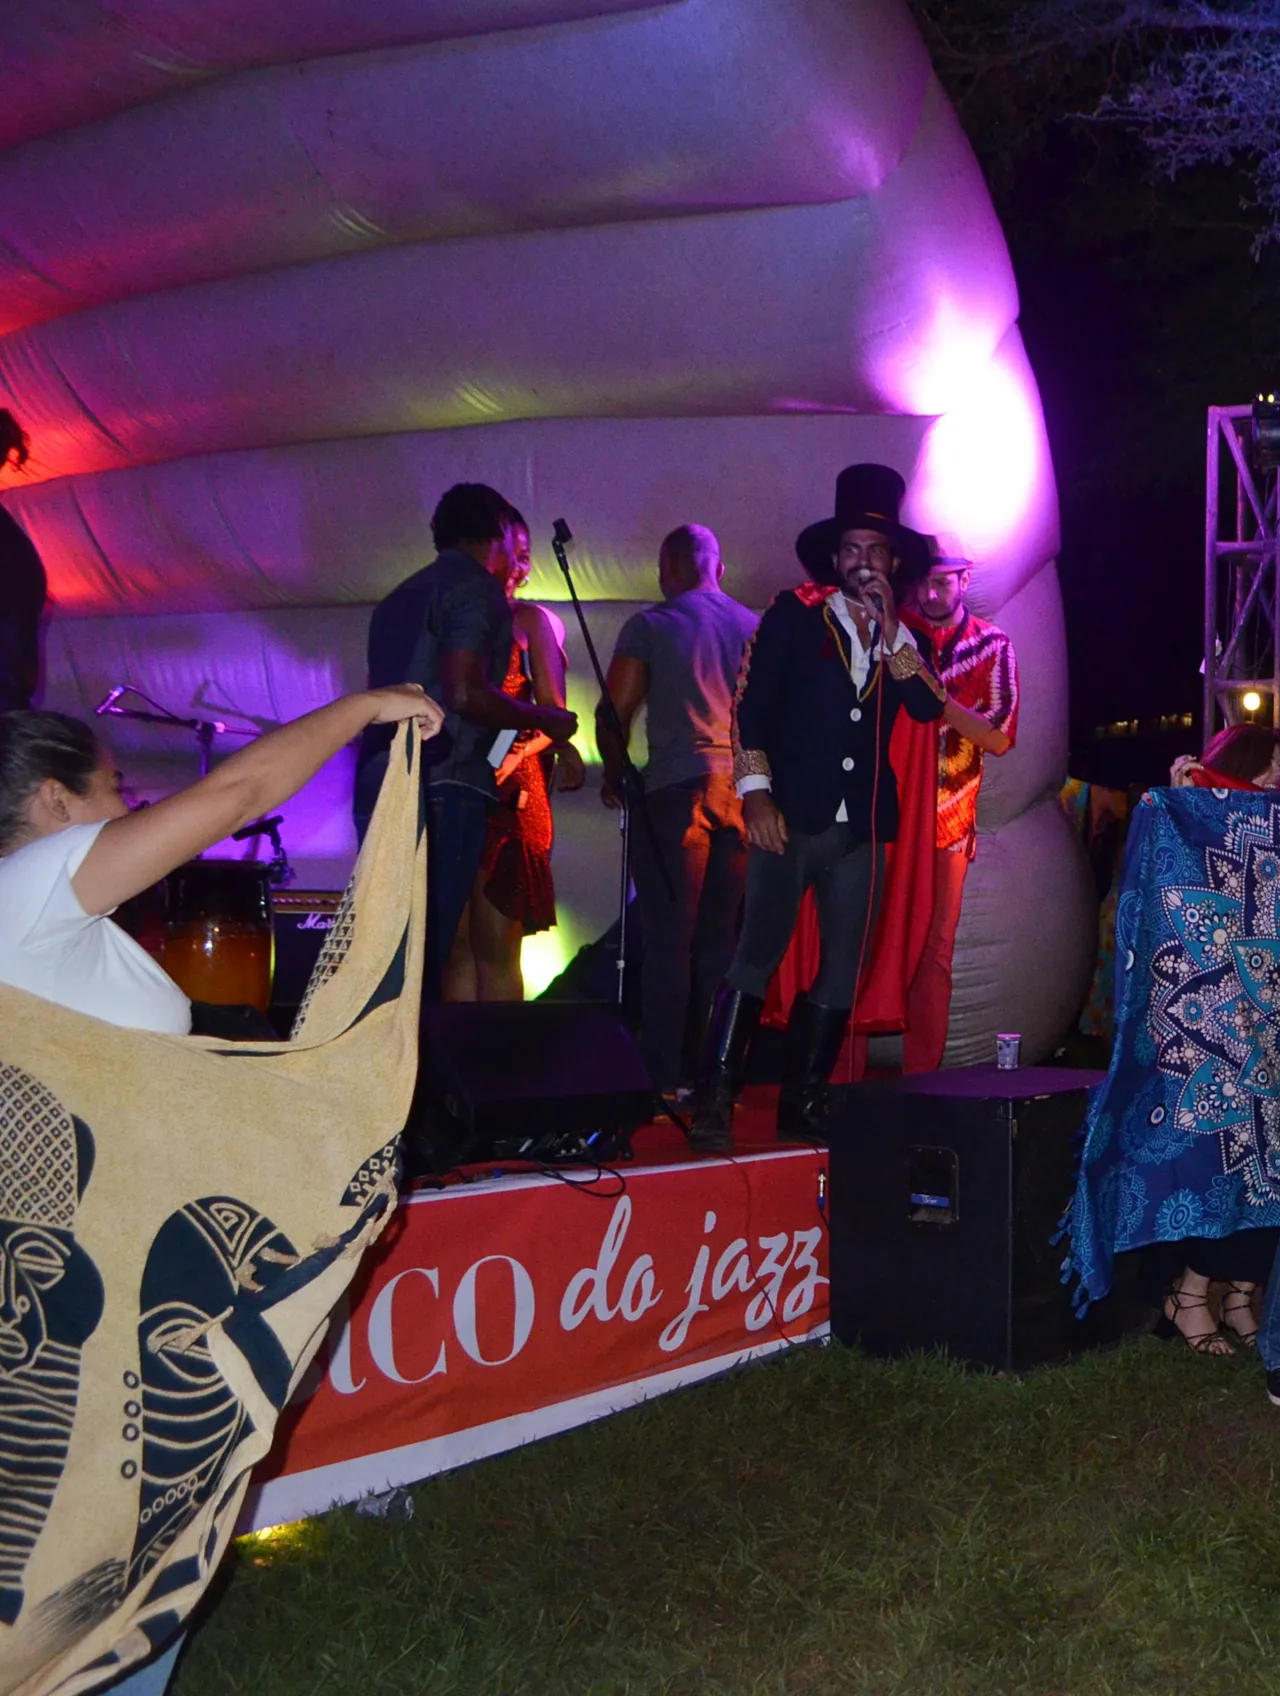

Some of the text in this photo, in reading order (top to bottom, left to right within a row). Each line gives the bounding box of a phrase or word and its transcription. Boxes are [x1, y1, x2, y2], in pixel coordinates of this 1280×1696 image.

[296, 912, 328, 930] Mar
[559, 1194, 663, 1331] do
[658, 1210, 830, 1352] jazz
